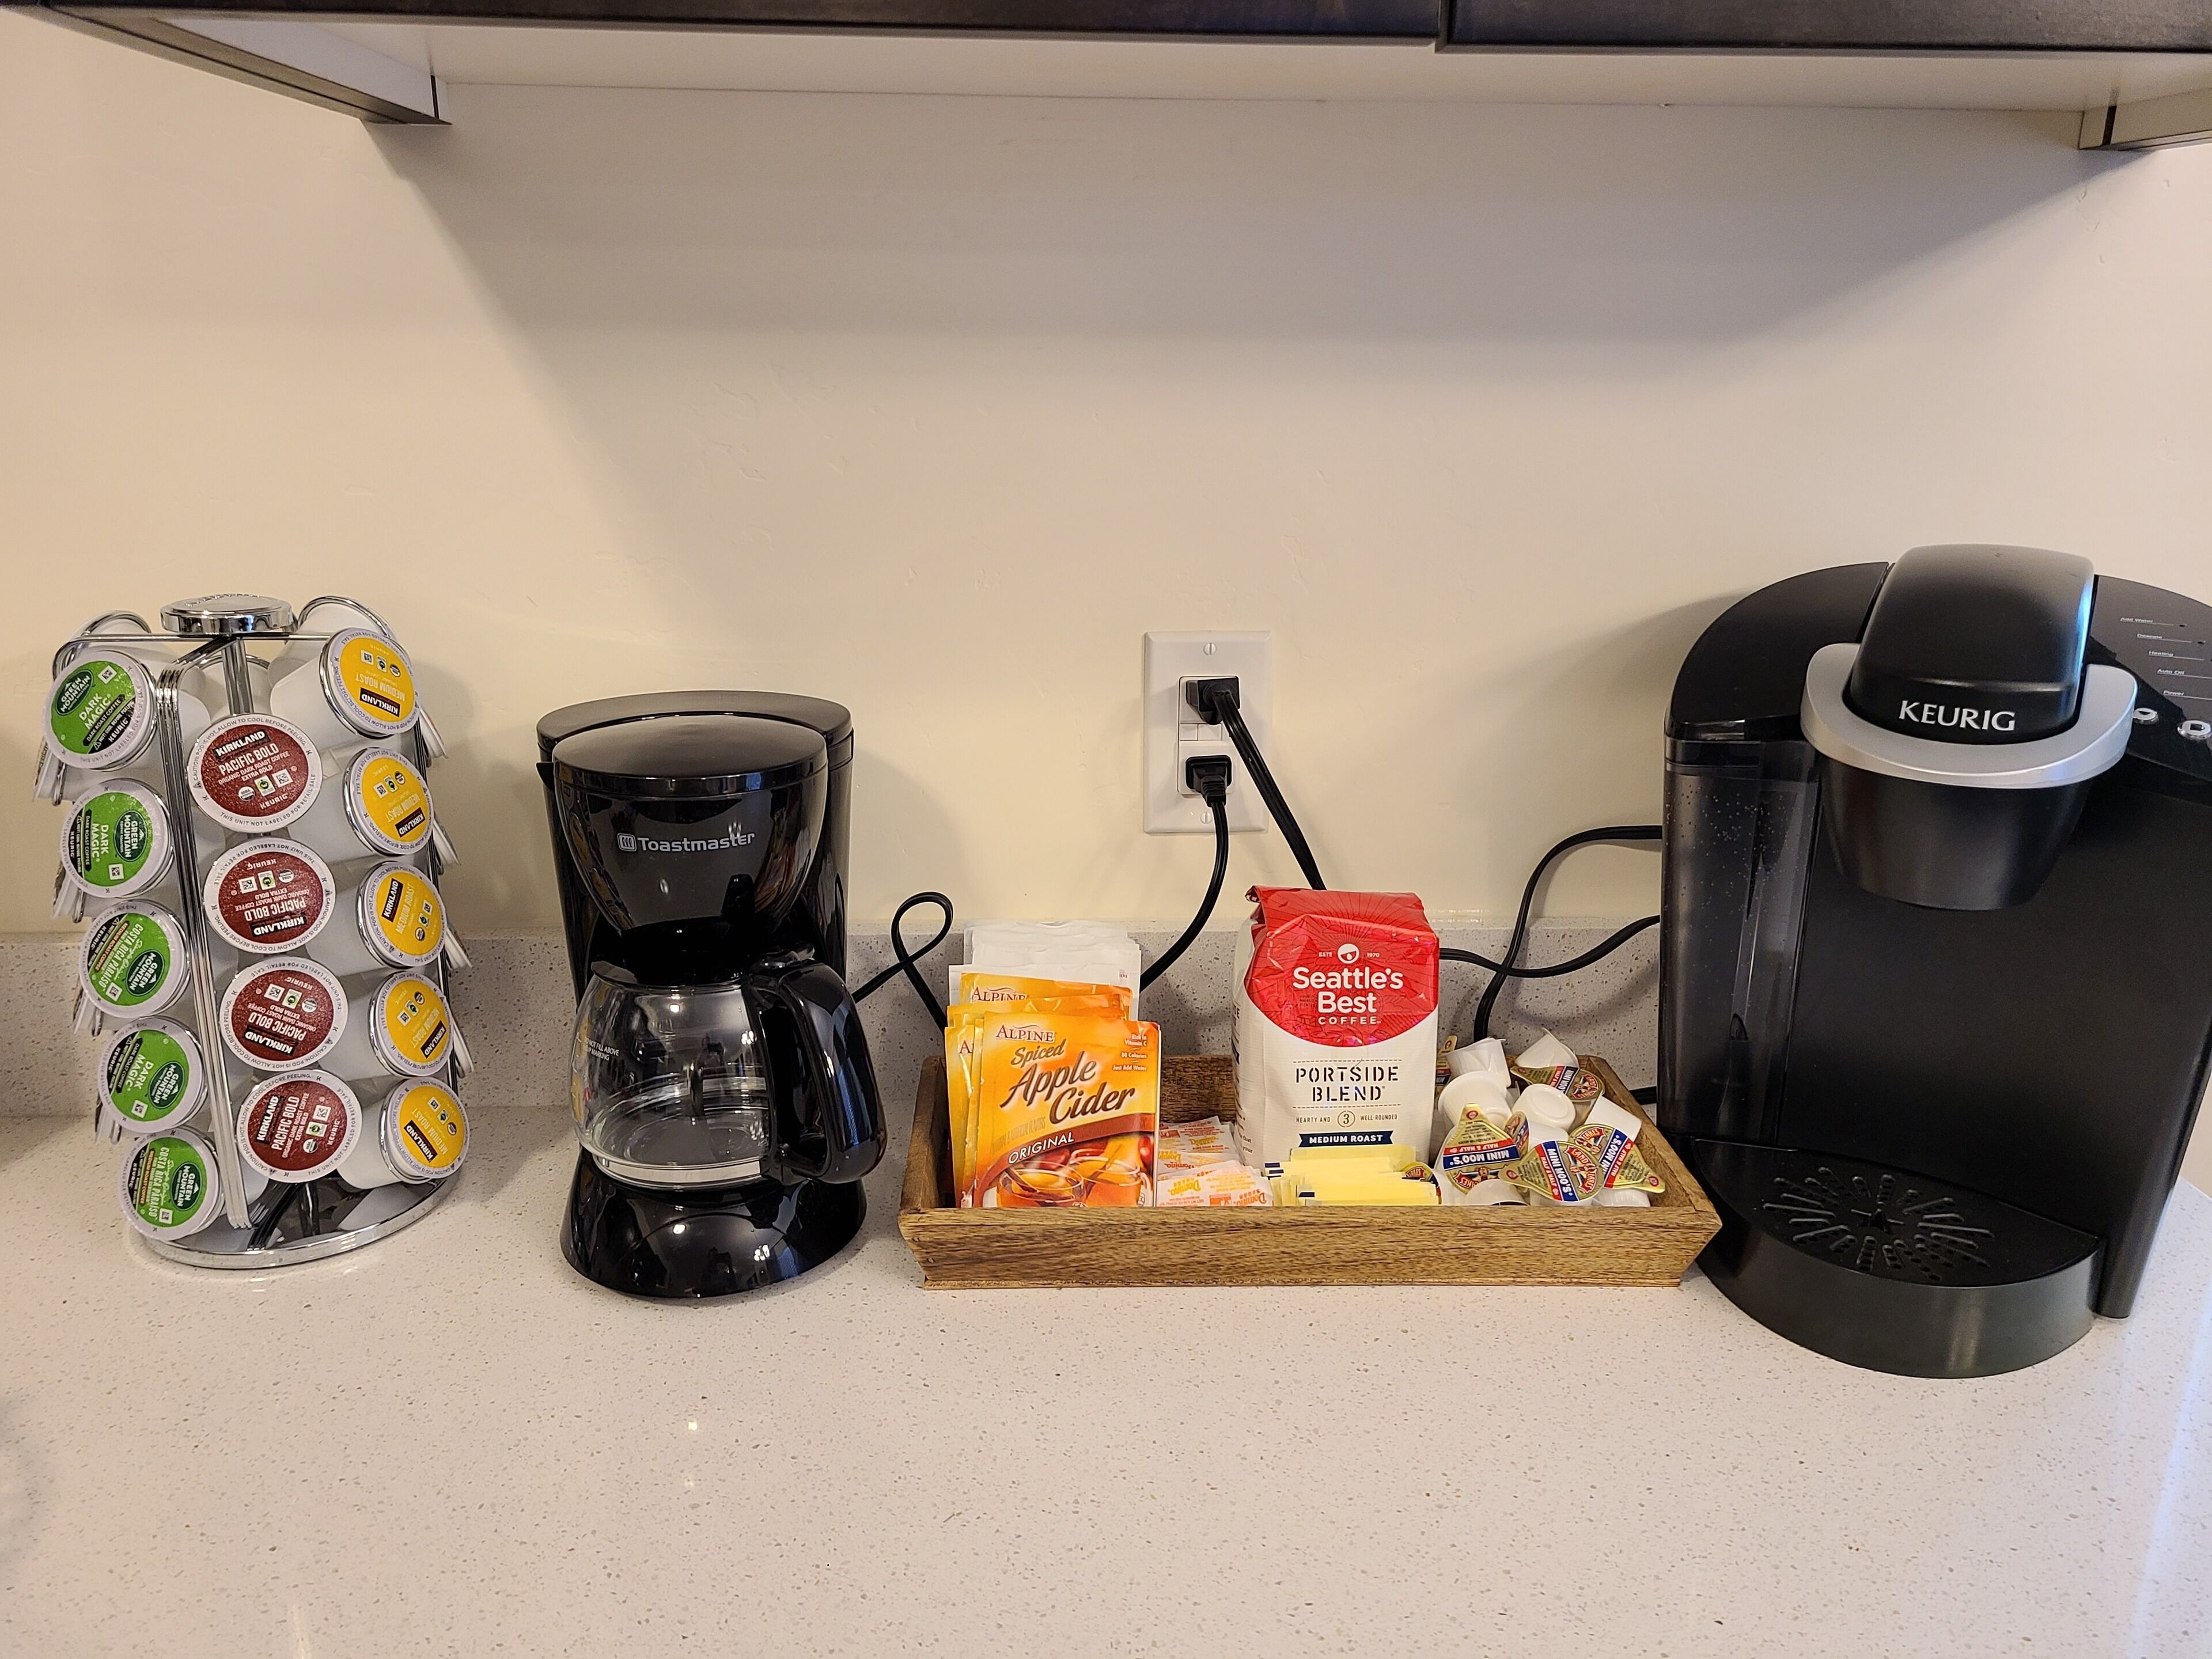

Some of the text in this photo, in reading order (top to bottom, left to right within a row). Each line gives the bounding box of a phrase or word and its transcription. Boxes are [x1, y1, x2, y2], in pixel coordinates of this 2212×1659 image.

[60, 677, 82, 703] GREEN
[355, 672, 378, 689] ROAST
[60, 675, 91, 713] MOUNTAIN
[361, 694, 398, 715] KIRKLAND
[380, 684, 406, 702] MEDIUM
[79, 693, 103, 721] DARK
[85, 698, 111, 730] MAGIC
[1899, 700, 2016, 732] KEURIG
[86, 699, 121, 741] DARK ROAST COFFEE
[108, 719, 128, 743] KEURIG
[215, 730, 266, 757] KIRKLAND
[218, 743, 279, 775] PACIFIC BOLD
[218, 751, 290, 785] ORGANIC DARK ROAST COFFEE
[241, 765, 273, 782] EXTRA BOLD
[260, 793, 287, 809] KEURIG
[401, 793, 420, 812] MEDIUM
[385, 806, 403, 823] ROAST
[399, 813, 424, 835] KIRKLAND
[92, 823, 100, 858] MAGIC
[101, 824, 109, 854] DARK
[637, 833, 755, 852] Toastmaster
[247, 858, 277, 870] KEURIG
[234, 889, 310, 912] ORGANIC DARK ROAST COFFEE
[255, 888, 287, 900] EXTRA BOLD
[383, 880, 399, 918] KIRKLAND
[244, 897, 306, 922] PACIFIC BOLD
[396, 904, 410, 934] MEDIUM
[405, 882, 415, 904] ROAST
[124, 923, 143, 946] COSTA
[253, 916, 305, 935] KIRKLAND
[116, 945, 129, 961] RICA
[130, 953, 157, 991] MOUNTAIN
[139, 962, 158, 988] GREEN
[286, 976, 313, 991] KEURIG
[1293, 967, 1403, 990] Seattle's
[971, 986, 1028, 1001] ALPINE
[1317, 991, 1377, 1013] Best
[248, 1002, 316, 1032] ORGANIC DARK ROAST COFFEE
[270, 1005, 301, 1020] EXTRA BOLD
[423, 1007, 440, 1031] MEDIUM
[1318, 1016, 1377, 1025] COFFEE
[248, 1012, 307, 1041] PACIFIC BOLD
[410, 1028, 427, 1049] ROAST
[995, 1024, 1055, 1042] ALPINE
[245, 1032, 293, 1054] KIRKLAND
[424, 1027, 445, 1056] KIRKLAND
[604, 1046, 620, 1056] ABOVE
[1010, 1038, 1067, 1069] Spiced
[108, 1047, 122, 1073] KEURIG
[591, 1048, 610, 1060] MARKING
[126, 1054, 146, 1088] MAGIC
[134, 1060, 154, 1090] DARK
[999, 1050, 1097, 1108] Apple
[1296, 1066, 1399, 1084] PORTSIDE
[153, 1064, 175, 1104] MOUNTAIN
[162, 1073, 179, 1100] GREEN
[1312, 1086, 1382, 1102] BLEND
[1048, 1081, 1136, 1124] Cider
[257, 1096, 279, 1142] KIRKLAND
[271, 1096, 300, 1150] PACIFIC BOLD
[282, 1092, 310, 1158] ORGANIC DARK ROAST COFFEE
[294, 1112, 309, 1141] EXTRA BOLD
[1343, 1113, 1349, 1124] 3
[327, 1119, 340, 1146] KEURIG
[406, 1124, 434, 1161] KIRKLAND
[411, 1108, 449, 1156] MEDIUM ROAST
[1189, 1137, 1217, 1146] Domino
[1243, 1135, 1252, 1143] that
[1309, 1136, 1347, 1144] MEDIUM
[1582, 1128, 1600, 1139] LAKES
[157, 1147, 169, 1169] COSTA
[1008, 1131, 1074, 1165] ORIGINAL
[1453, 1150, 1509, 1164] MINI MOO'S
[1571, 1149, 1589, 1164] LAND
[1605, 1138, 1622, 1161] MOO'S
[1541, 1157, 1550, 1170] HALF
[1548, 1173, 1557, 1186] HALF
[1547, 1149, 1571, 1193] MINI MOO'S
[1611, 1165, 1619, 1176] HALF
[1619, 1149, 1627, 1161] HALF
[153, 1171, 164, 1187] RICA
[177, 1165, 191, 1207] MOUNTAIN
[184, 1173, 195, 1201] GREEN
[1170, 1179, 1201, 1196] Domino
[1585, 1172, 1595, 1189] LAKES
[1236, 1192, 1267, 1206] Domino
